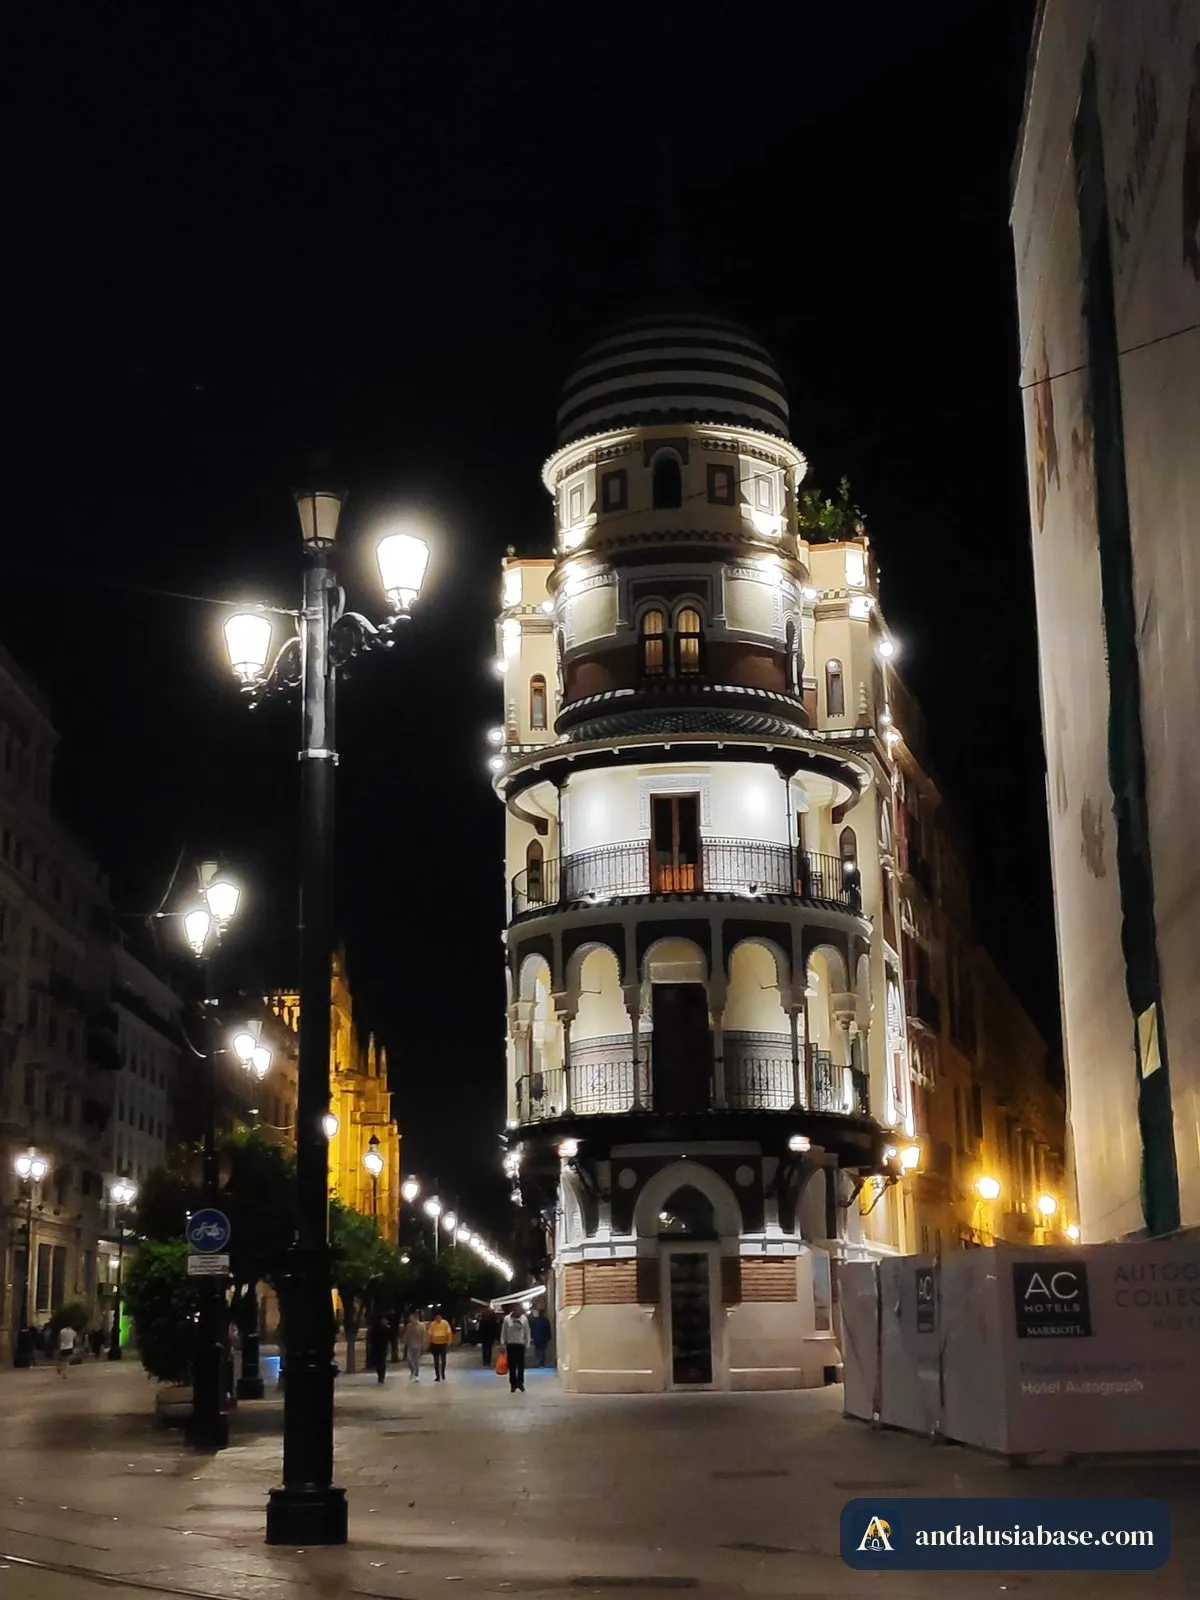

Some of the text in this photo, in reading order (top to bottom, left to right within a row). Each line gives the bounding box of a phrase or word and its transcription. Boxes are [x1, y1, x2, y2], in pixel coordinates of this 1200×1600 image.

[1024, 1271, 1079, 1299] AC
[1024, 1303, 1081, 1314] HOTELS
[1021, 1378, 1144, 1395] Hotel Autograph
